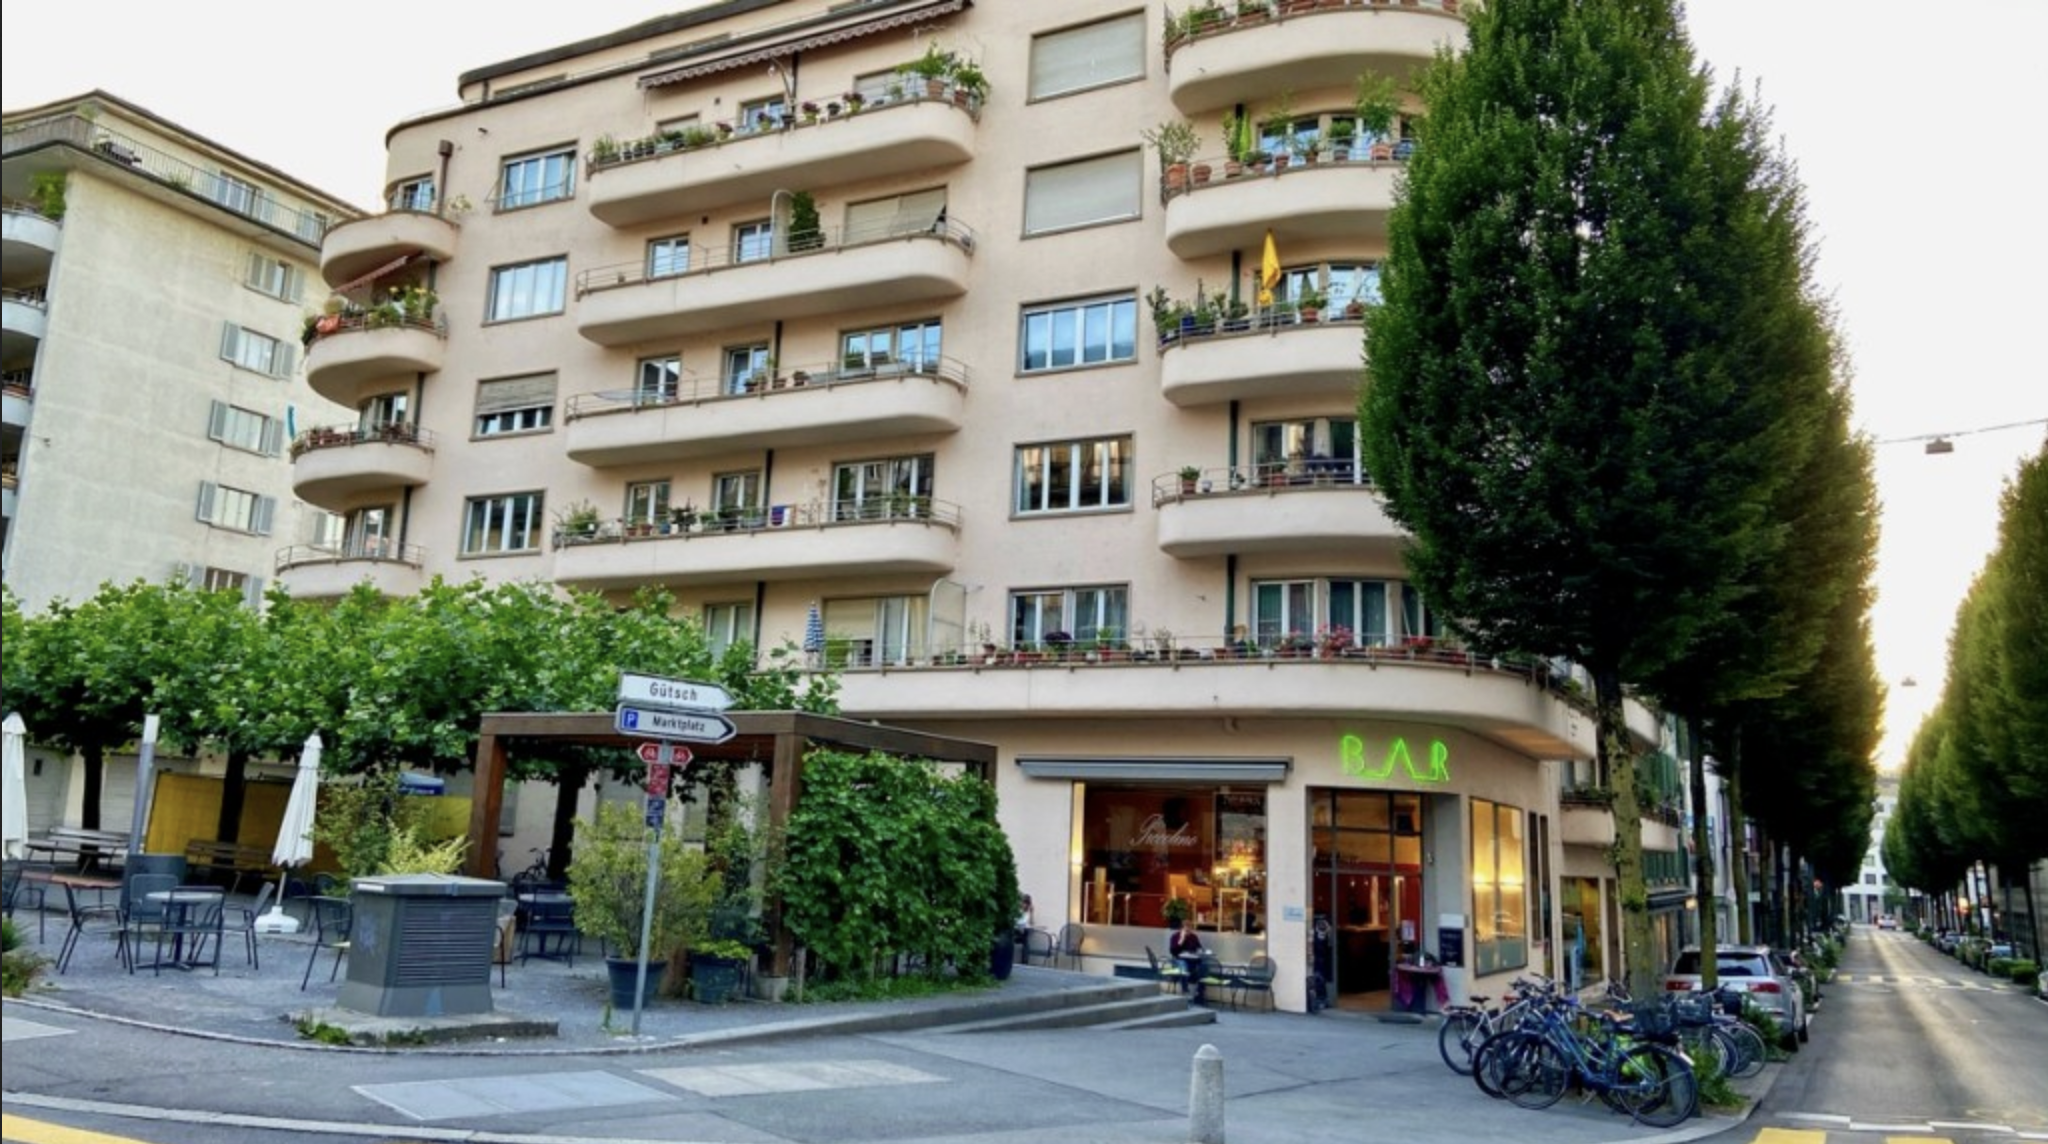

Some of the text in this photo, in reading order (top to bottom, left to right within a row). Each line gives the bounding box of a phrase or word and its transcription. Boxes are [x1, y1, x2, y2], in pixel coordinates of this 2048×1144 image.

[649, 681, 698, 700] Gütsch
[627, 713, 705, 733] P Marktplatz
